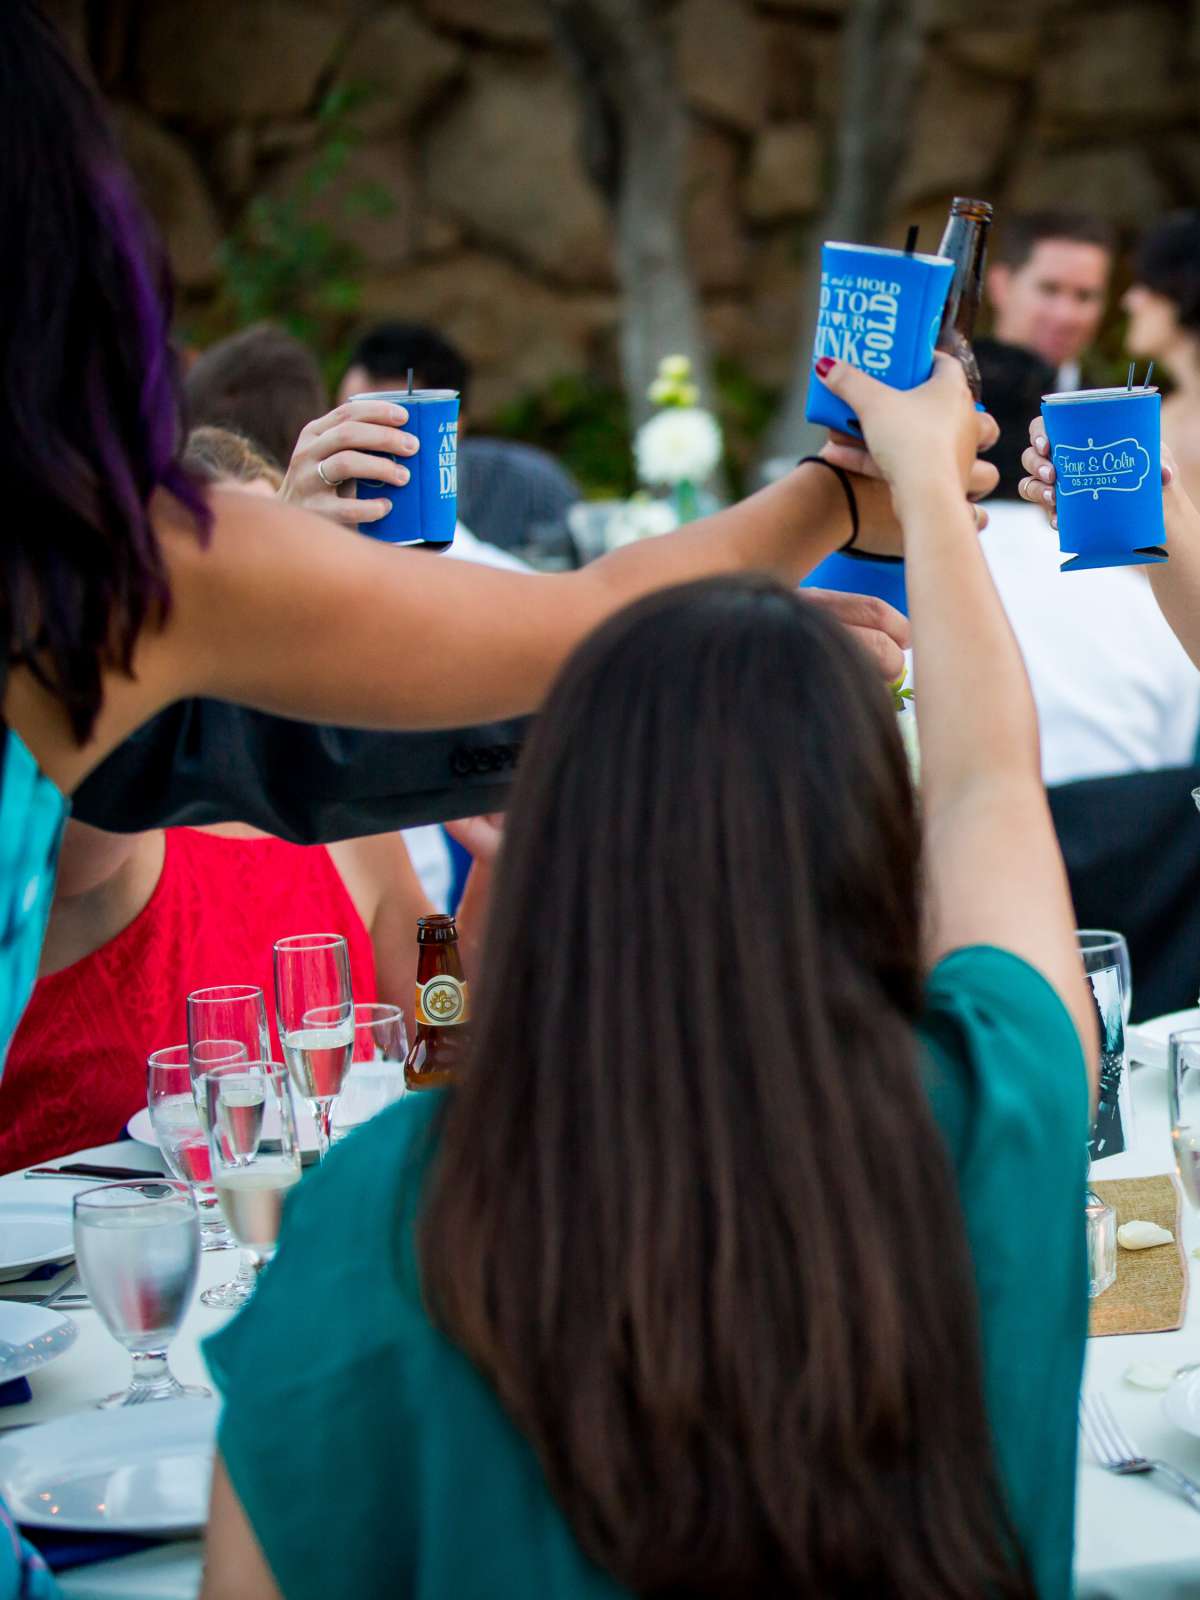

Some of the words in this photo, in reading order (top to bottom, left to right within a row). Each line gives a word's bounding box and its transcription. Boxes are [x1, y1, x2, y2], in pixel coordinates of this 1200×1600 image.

[856, 277, 901, 295] HOLD
[834, 288, 868, 314] TO
[862, 293, 897, 369] COLD
[1058, 455, 1086, 476] Faye
[1088, 456, 1100, 472] &
[1103, 451, 1136, 472] Colin
[1071, 476, 1118, 487] 05.27.2016
